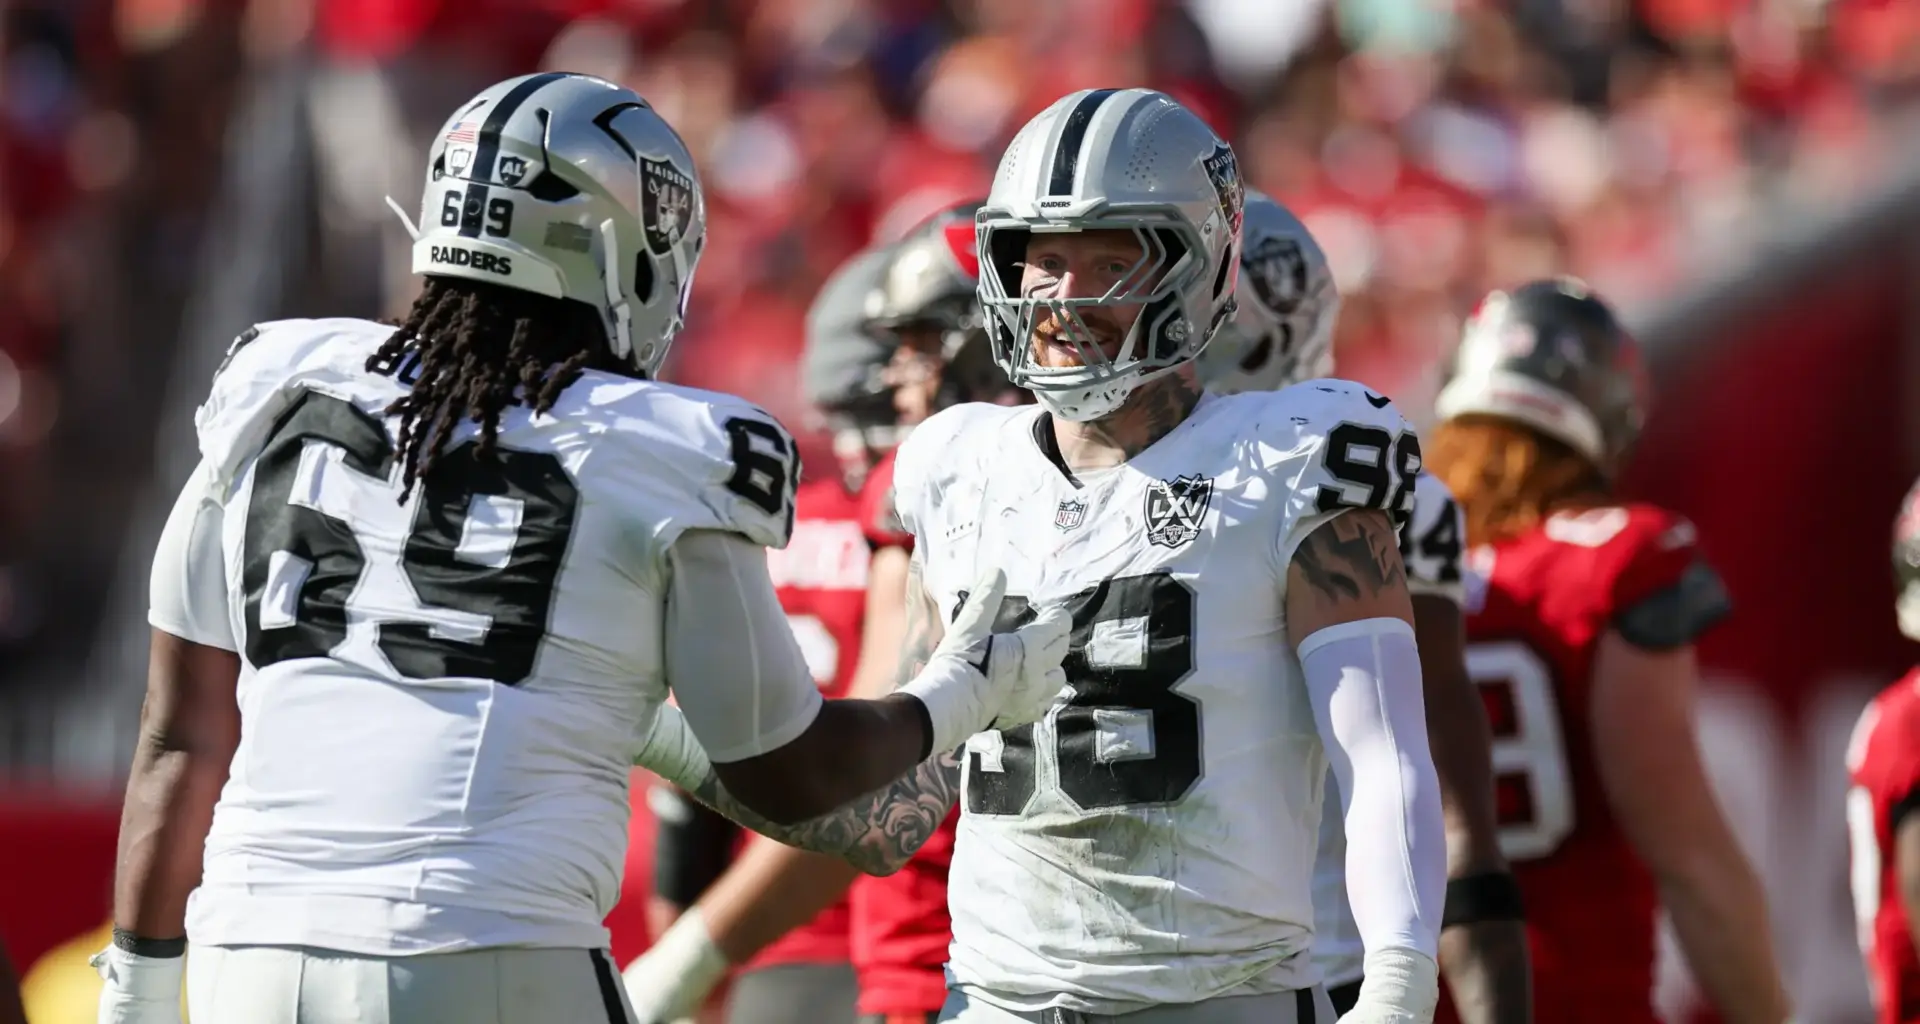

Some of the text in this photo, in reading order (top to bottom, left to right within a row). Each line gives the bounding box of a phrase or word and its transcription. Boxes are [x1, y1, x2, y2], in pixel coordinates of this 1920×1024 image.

[501, 160, 523, 178] AL
[646, 161, 690, 191] RAIDERS
[441, 189, 514, 238] 69
[431, 246, 511, 275] RAIDERS
[1058, 511, 1078, 525] NFL
[1151, 494, 1206, 519] LXV
[242, 389, 581, 687] 69
